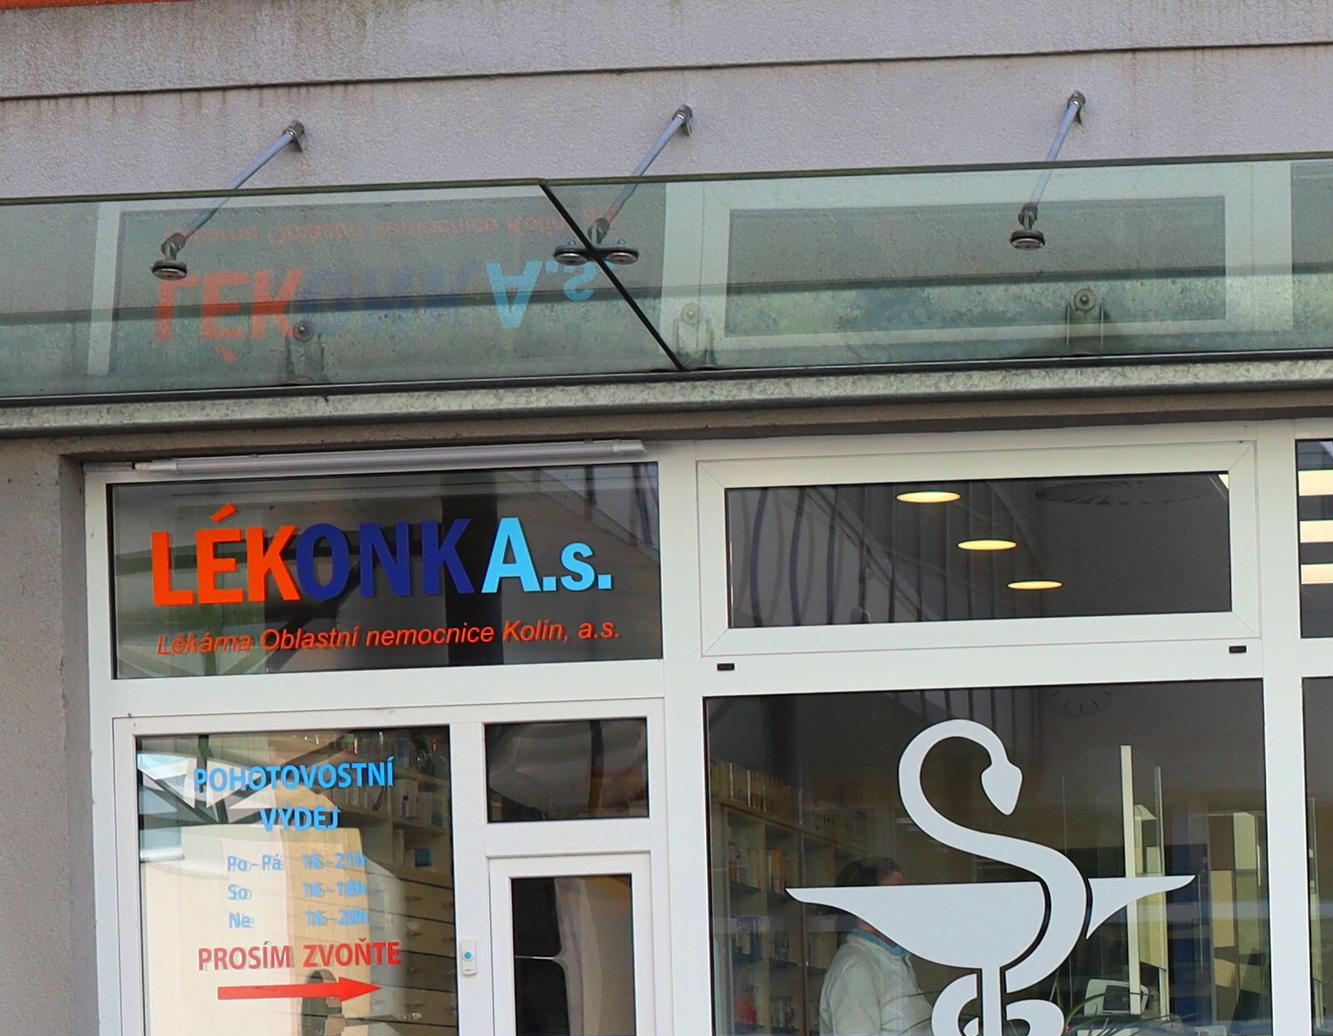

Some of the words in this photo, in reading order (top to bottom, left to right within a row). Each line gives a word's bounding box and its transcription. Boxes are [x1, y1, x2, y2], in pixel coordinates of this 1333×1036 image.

[157, 631, 251, 656] Lékárna
[260, 625, 360, 650] Oblastní
[366, 623, 494, 647] nemocnice
[578, 619, 620, 640] a.s.
[194, 756, 396, 792] POHOTOVOSTNÍ
[260, 803, 341, 832] VÝDEJ
[198, 941, 294, 971] PROSÍM
[303, 938, 401, 968] ZVOŇTE
